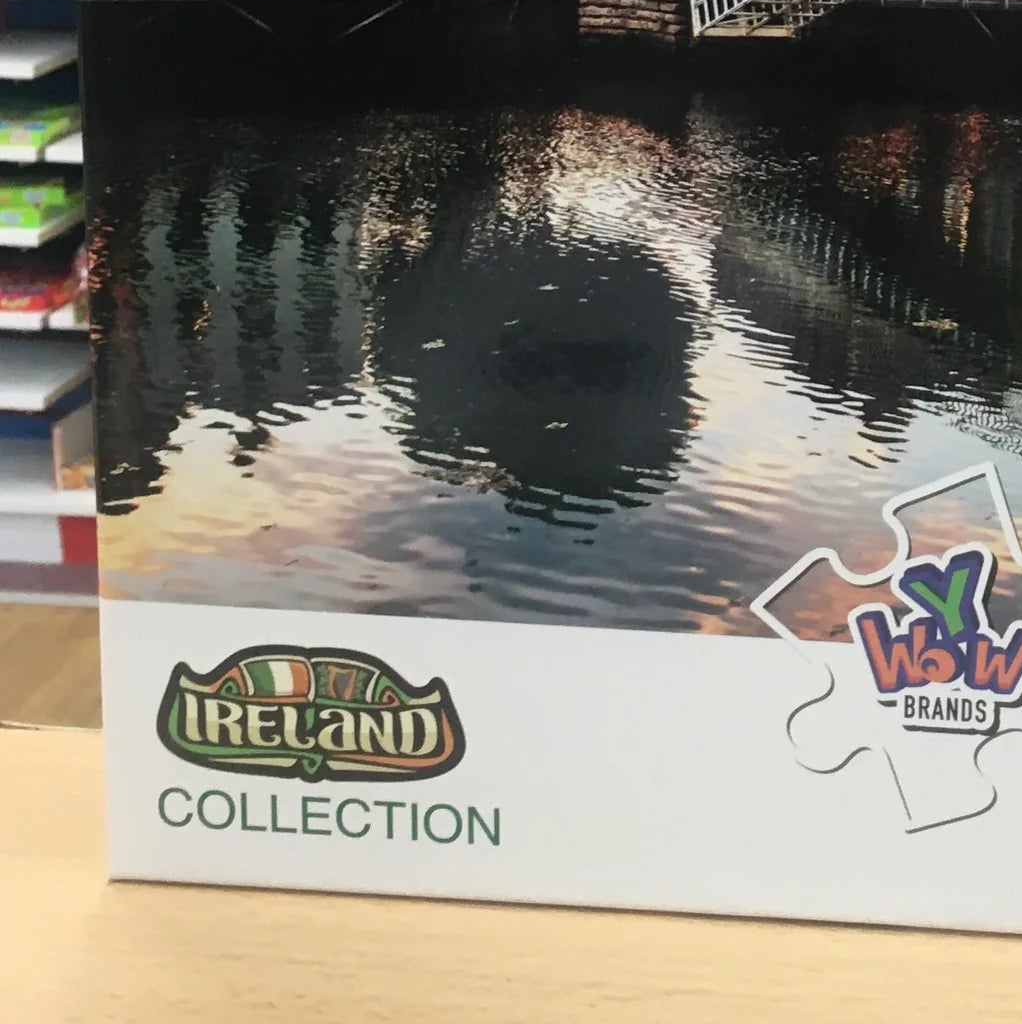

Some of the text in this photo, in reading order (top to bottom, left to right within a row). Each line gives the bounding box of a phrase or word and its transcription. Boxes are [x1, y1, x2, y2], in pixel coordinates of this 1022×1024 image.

[904, 560, 978, 638] Y
[903, 694, 987, 724] BRANDS
[157, 786, 501, 847] COLLECTION
